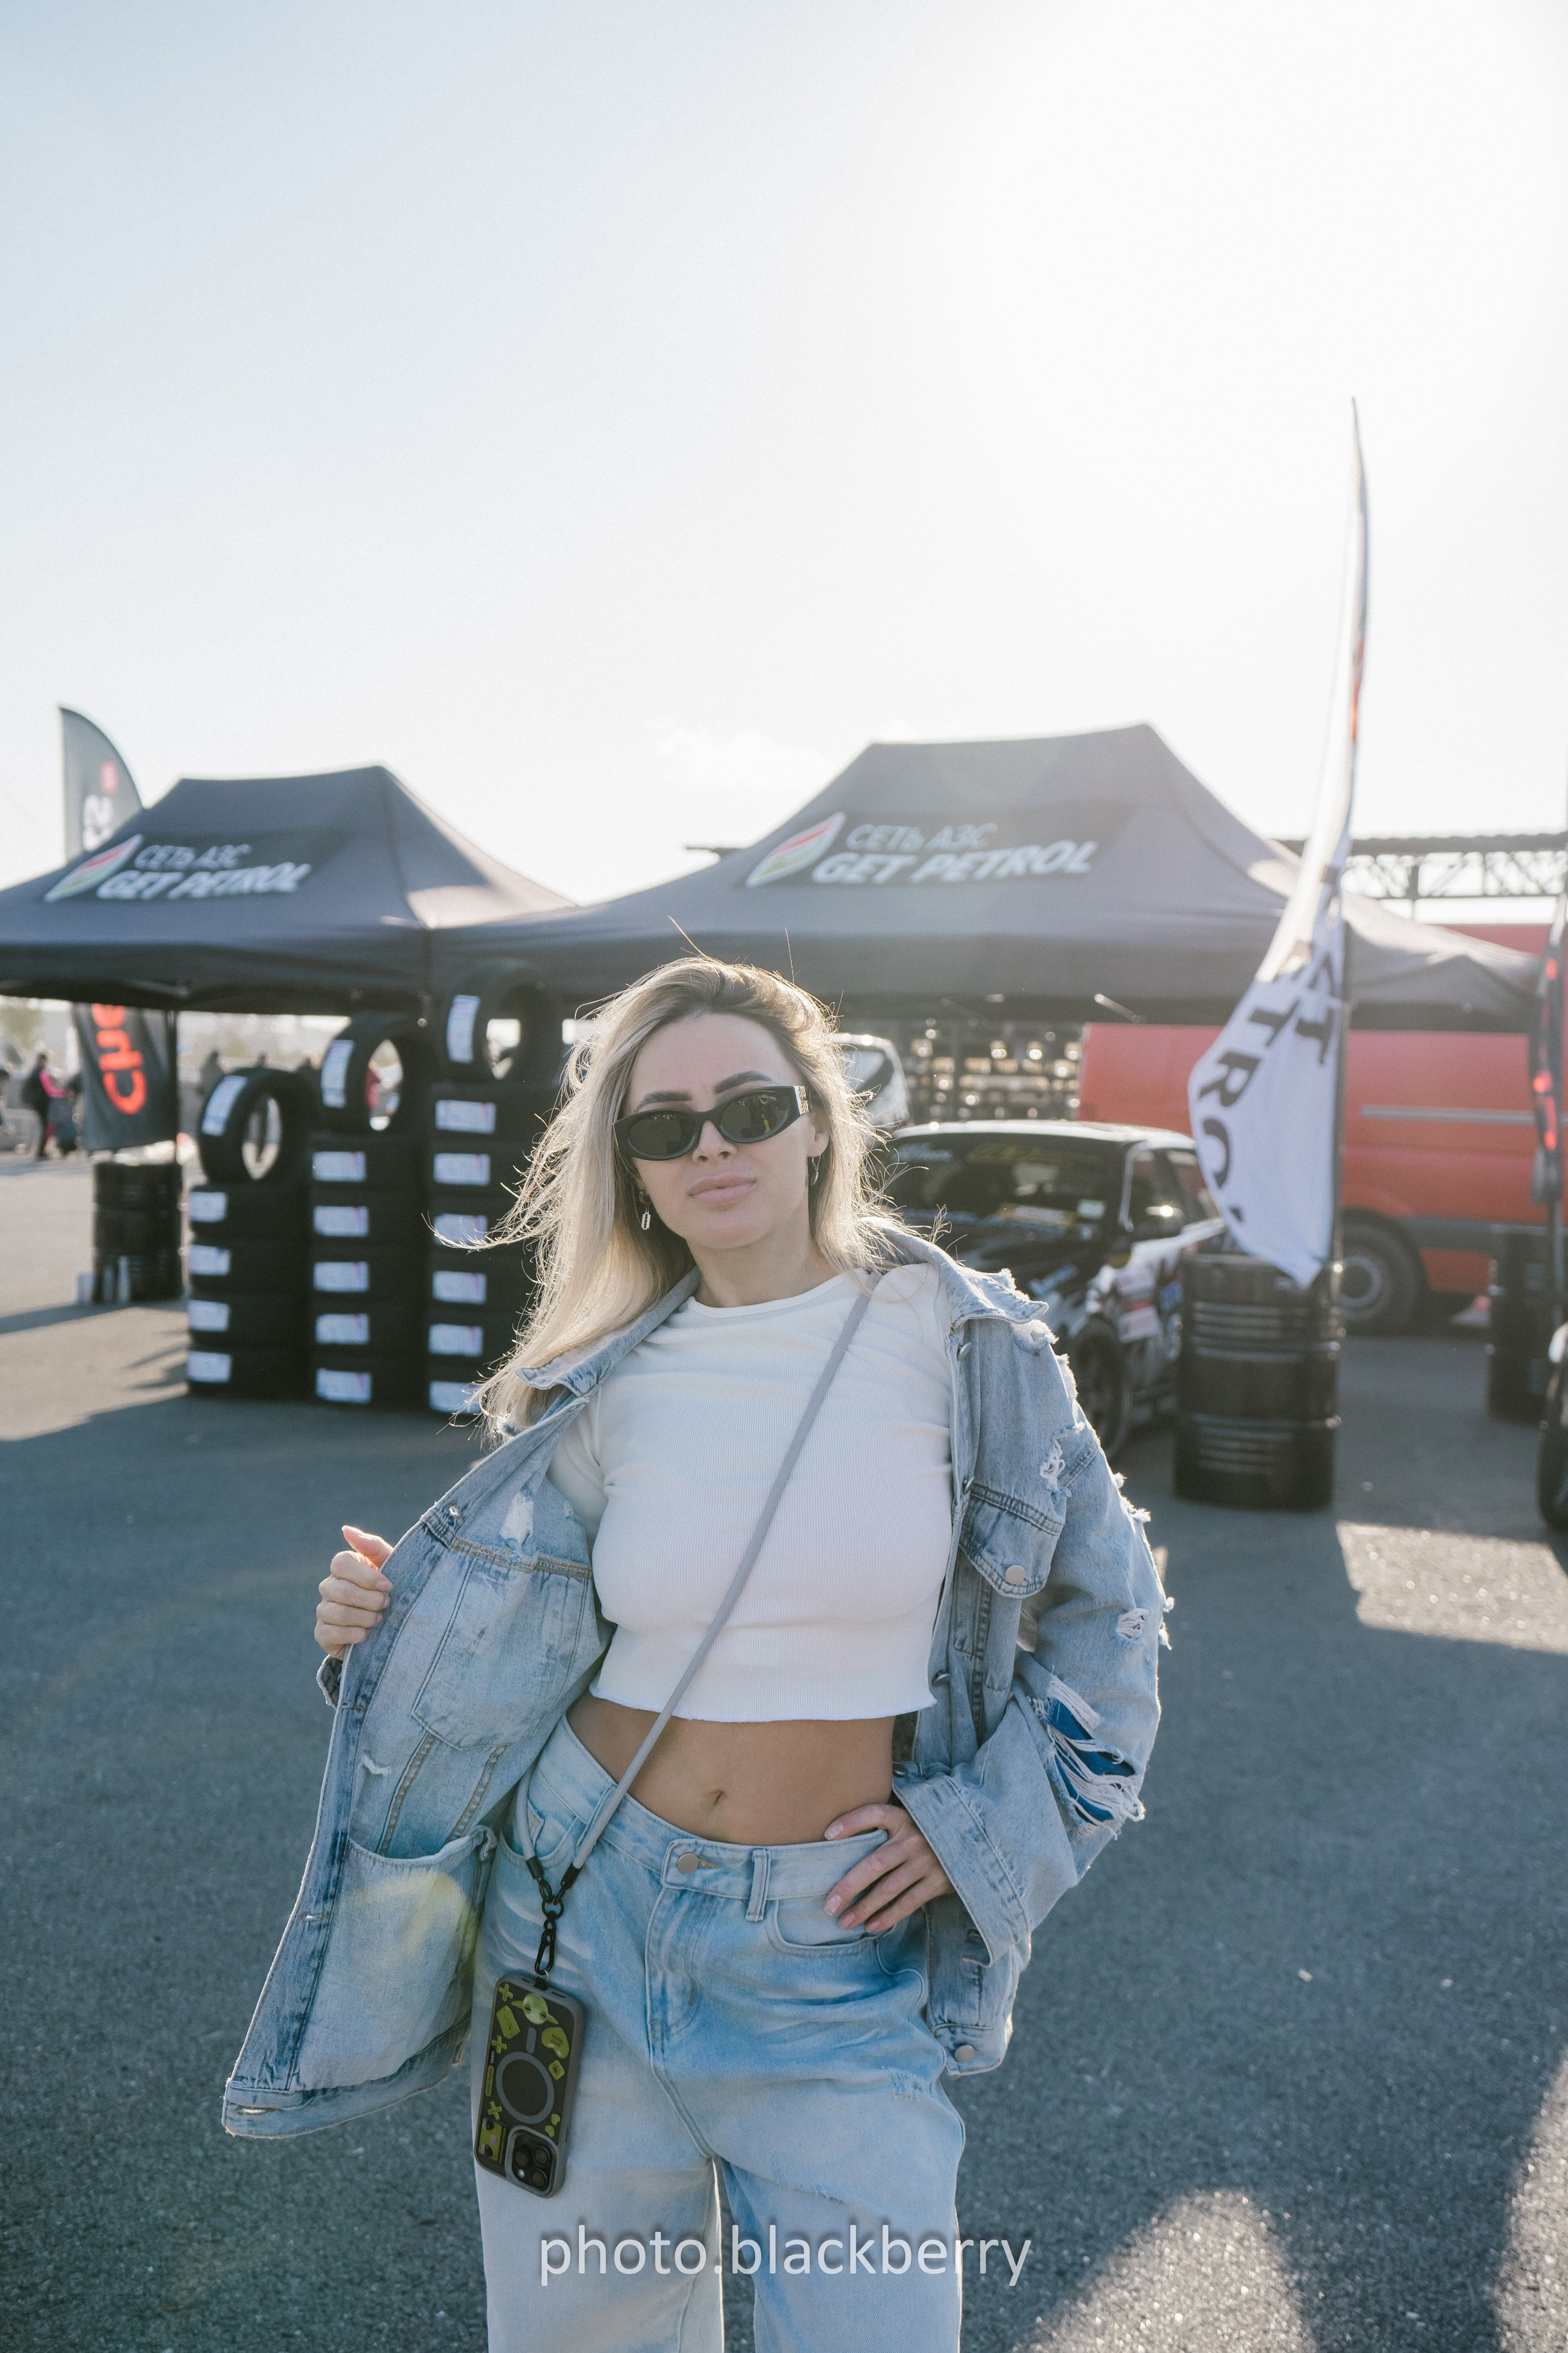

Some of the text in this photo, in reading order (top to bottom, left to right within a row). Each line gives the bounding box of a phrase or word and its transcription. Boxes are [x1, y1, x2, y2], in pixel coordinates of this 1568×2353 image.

[96, 861, 311, 899] GET PETROL
[812, 839, 1098, 884] GET PETROL
